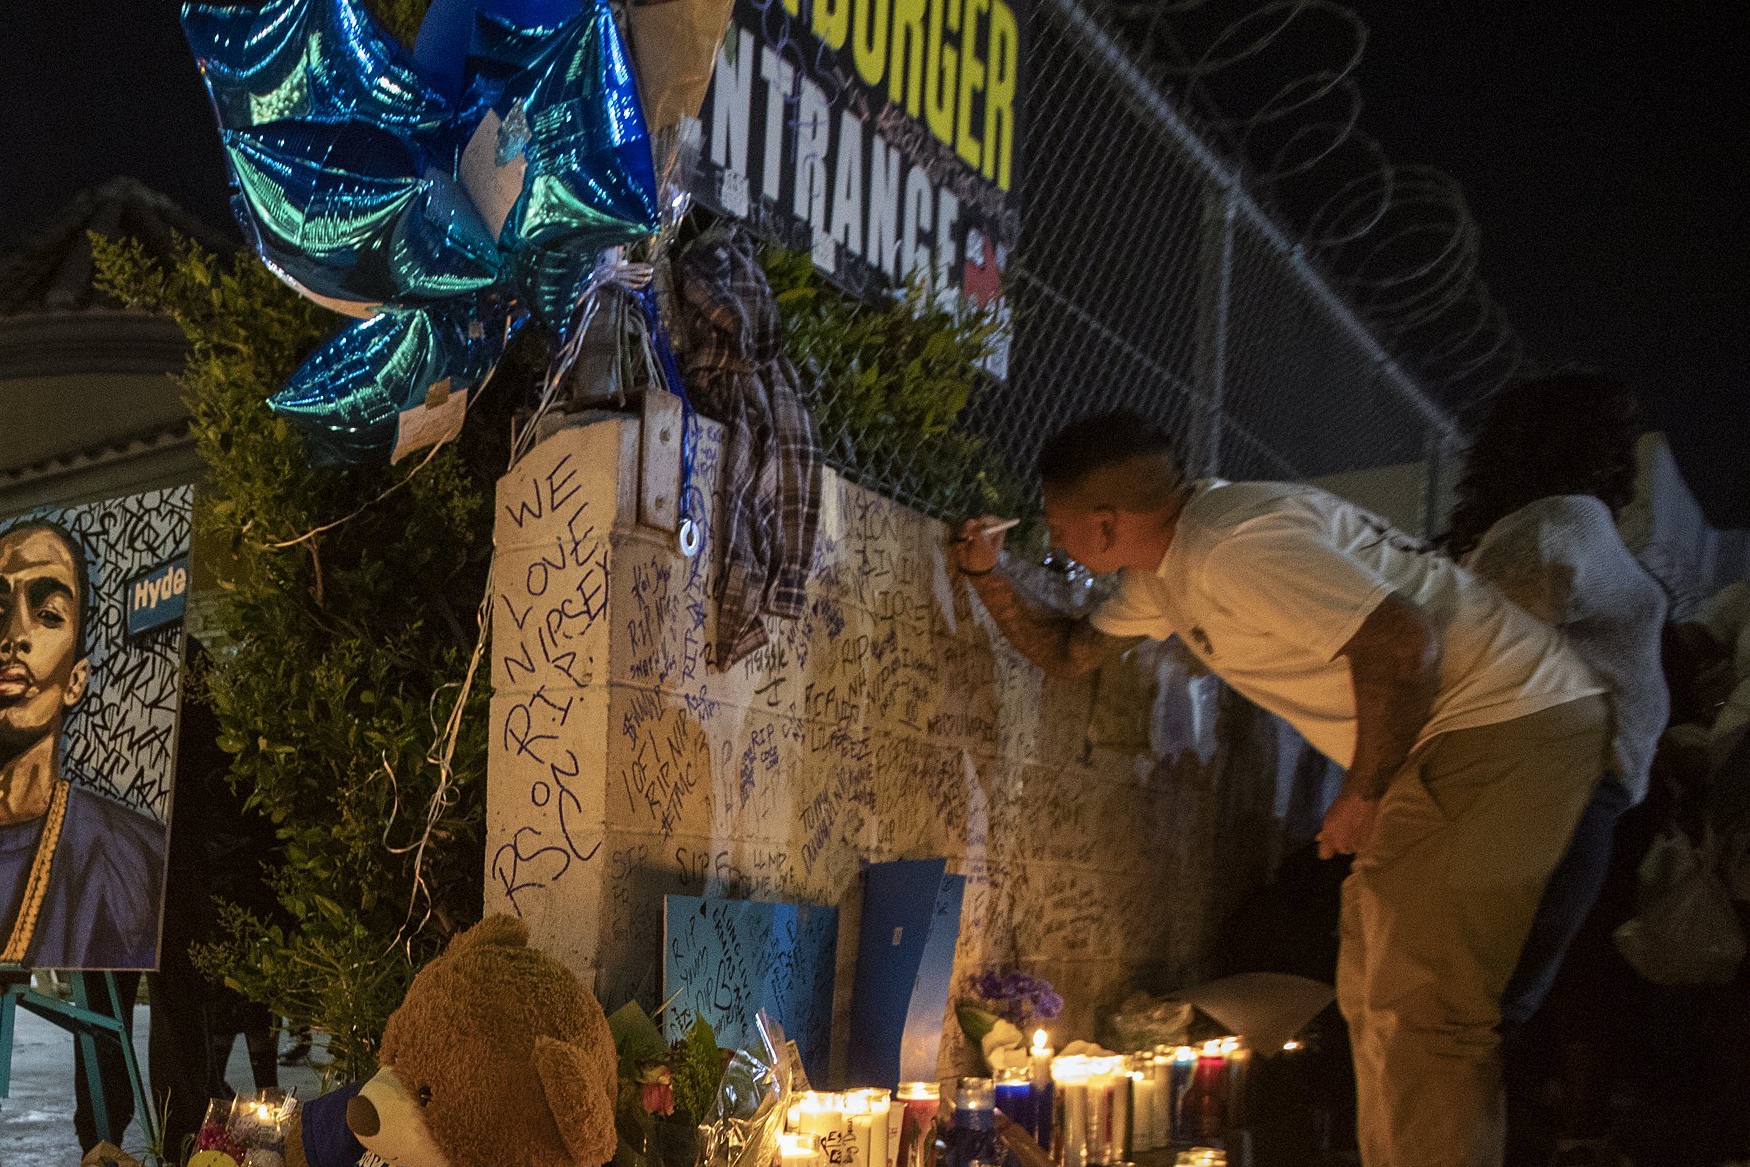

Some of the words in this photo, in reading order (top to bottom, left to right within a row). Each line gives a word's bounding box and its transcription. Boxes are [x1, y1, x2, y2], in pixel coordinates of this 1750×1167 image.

[505, 453, 582, 528] WE
[134, 566, 187, 611] Hyde
[501, 502, 600, 630] LOVE
[503, 550, 610, 684] NIPSEY
